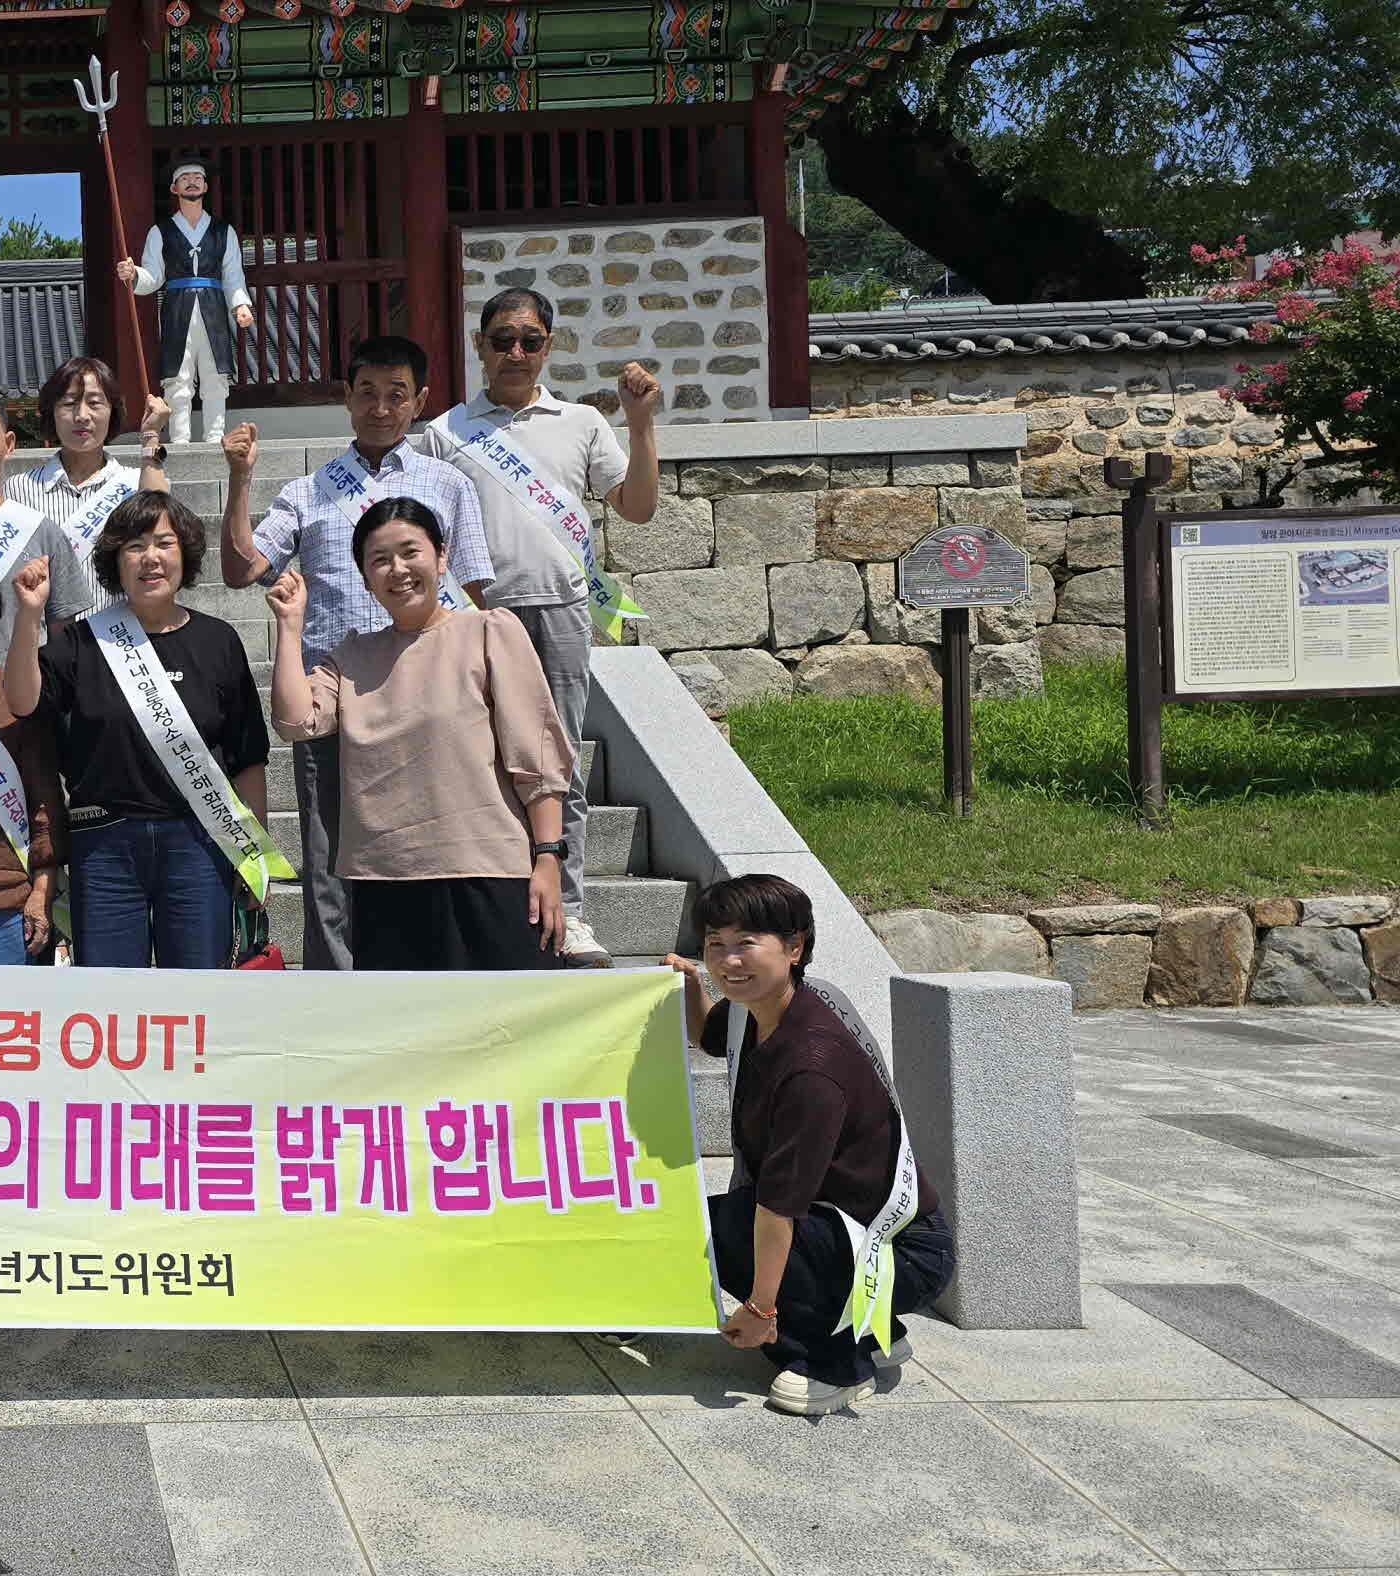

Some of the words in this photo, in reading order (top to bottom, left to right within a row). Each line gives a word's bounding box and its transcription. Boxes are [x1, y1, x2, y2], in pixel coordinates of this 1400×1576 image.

[469, 430, 532, 482] 청소년에게
[526, 479, 566, 515] 사랑과
[60, 1013, 206, 1074] OUT!
[65, 1103, 255, 1211] 미래를
[276, 1105, 408, 1212] 밝게
[426, 1101, 656, 1211] 합니다.
